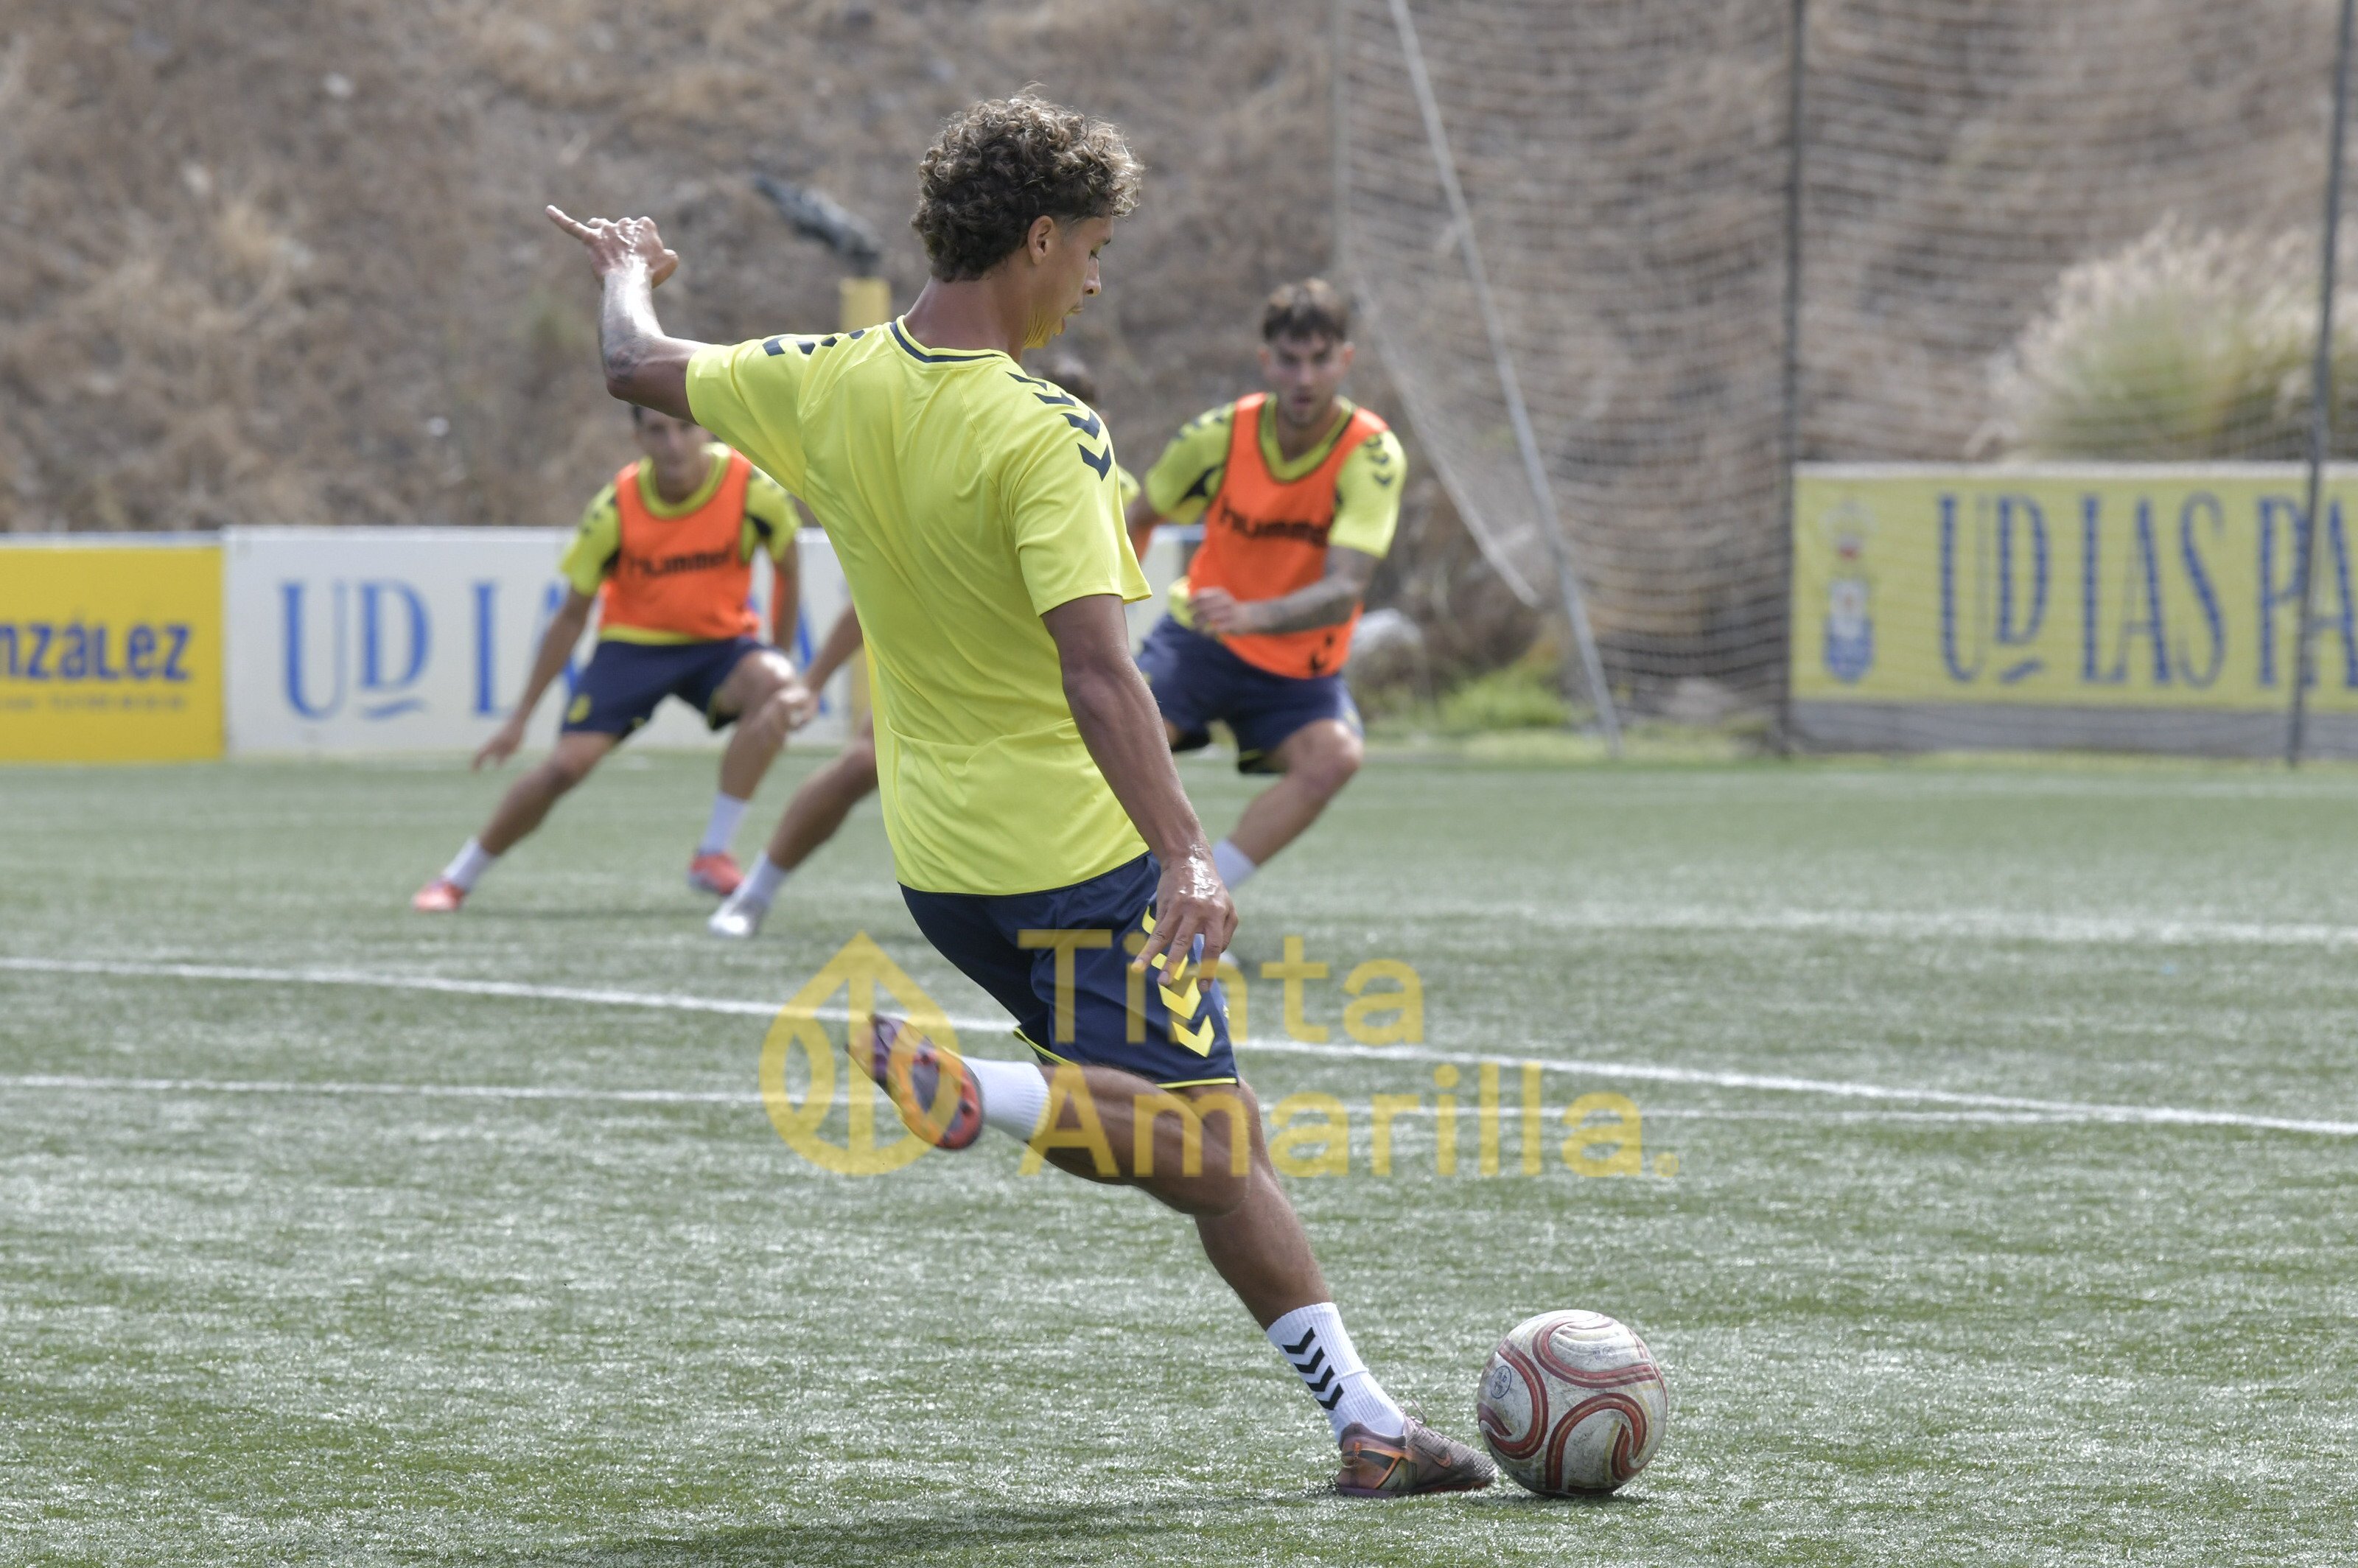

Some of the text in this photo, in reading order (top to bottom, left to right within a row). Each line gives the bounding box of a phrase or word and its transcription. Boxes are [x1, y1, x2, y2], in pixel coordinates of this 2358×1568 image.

[279, 578, 434, 721] UD
[1937, 492, 2051, 684] UD
[2079, 489, 2228, 690] LAS
